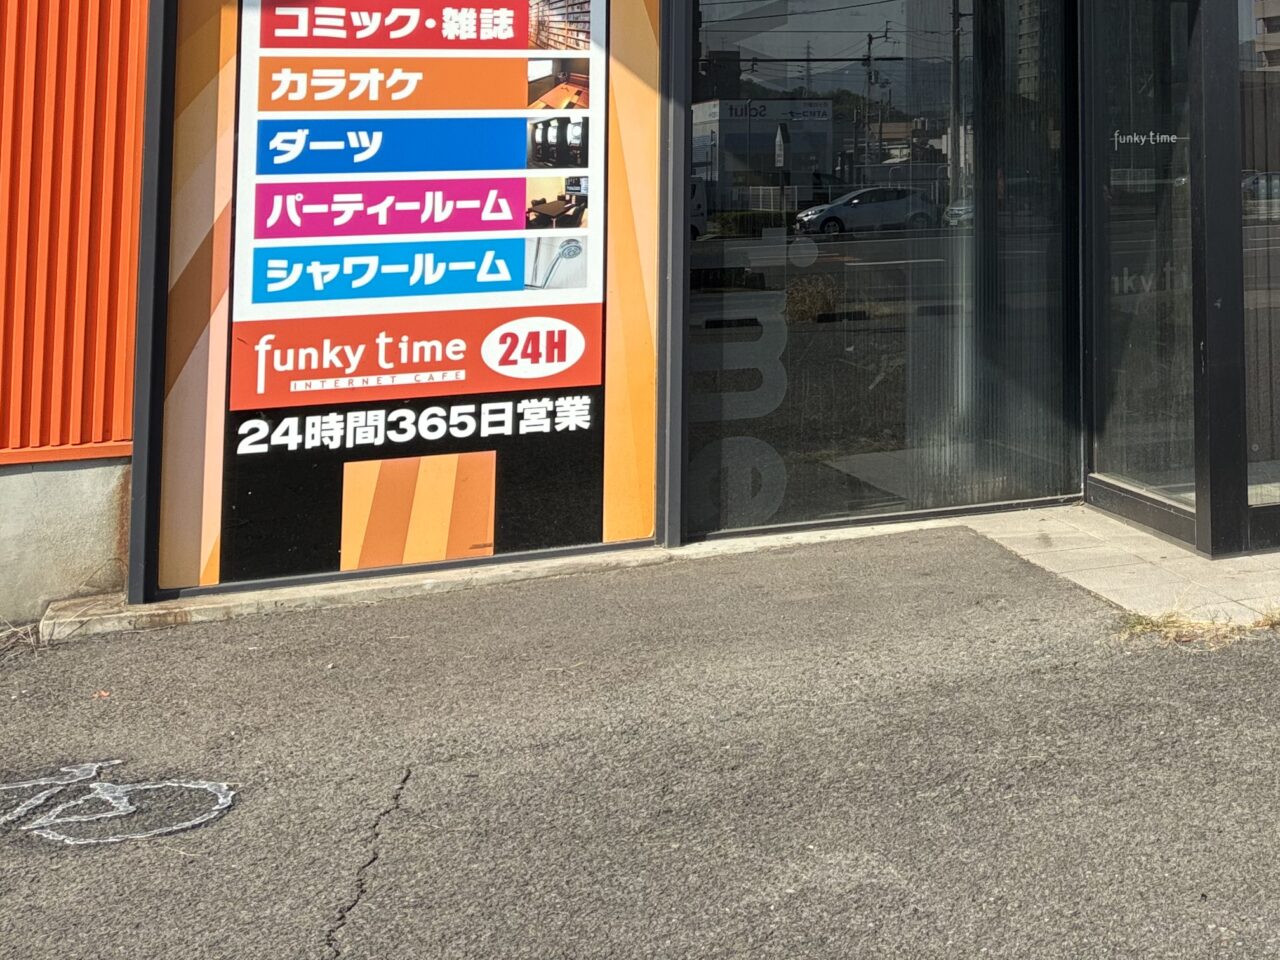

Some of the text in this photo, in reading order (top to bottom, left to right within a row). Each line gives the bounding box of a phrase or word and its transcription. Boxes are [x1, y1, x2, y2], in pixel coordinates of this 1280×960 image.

[273, 5, 515, 41] コミック・雑誌
[270, 67, 424, 102] カラオケ
[268, 128, 383, 165] ダーツ
[1114, 129, 1178, 151] funky time
[266, 189, 514, 228] パーティールーム
[266, 250, 513, 293] シャワールーム
[255, 329, 567, 395] funky time 24H
[293, 371, 462, 391] INTERNET CAFE
[236, 395, 592, 455] 24時間365日営業
